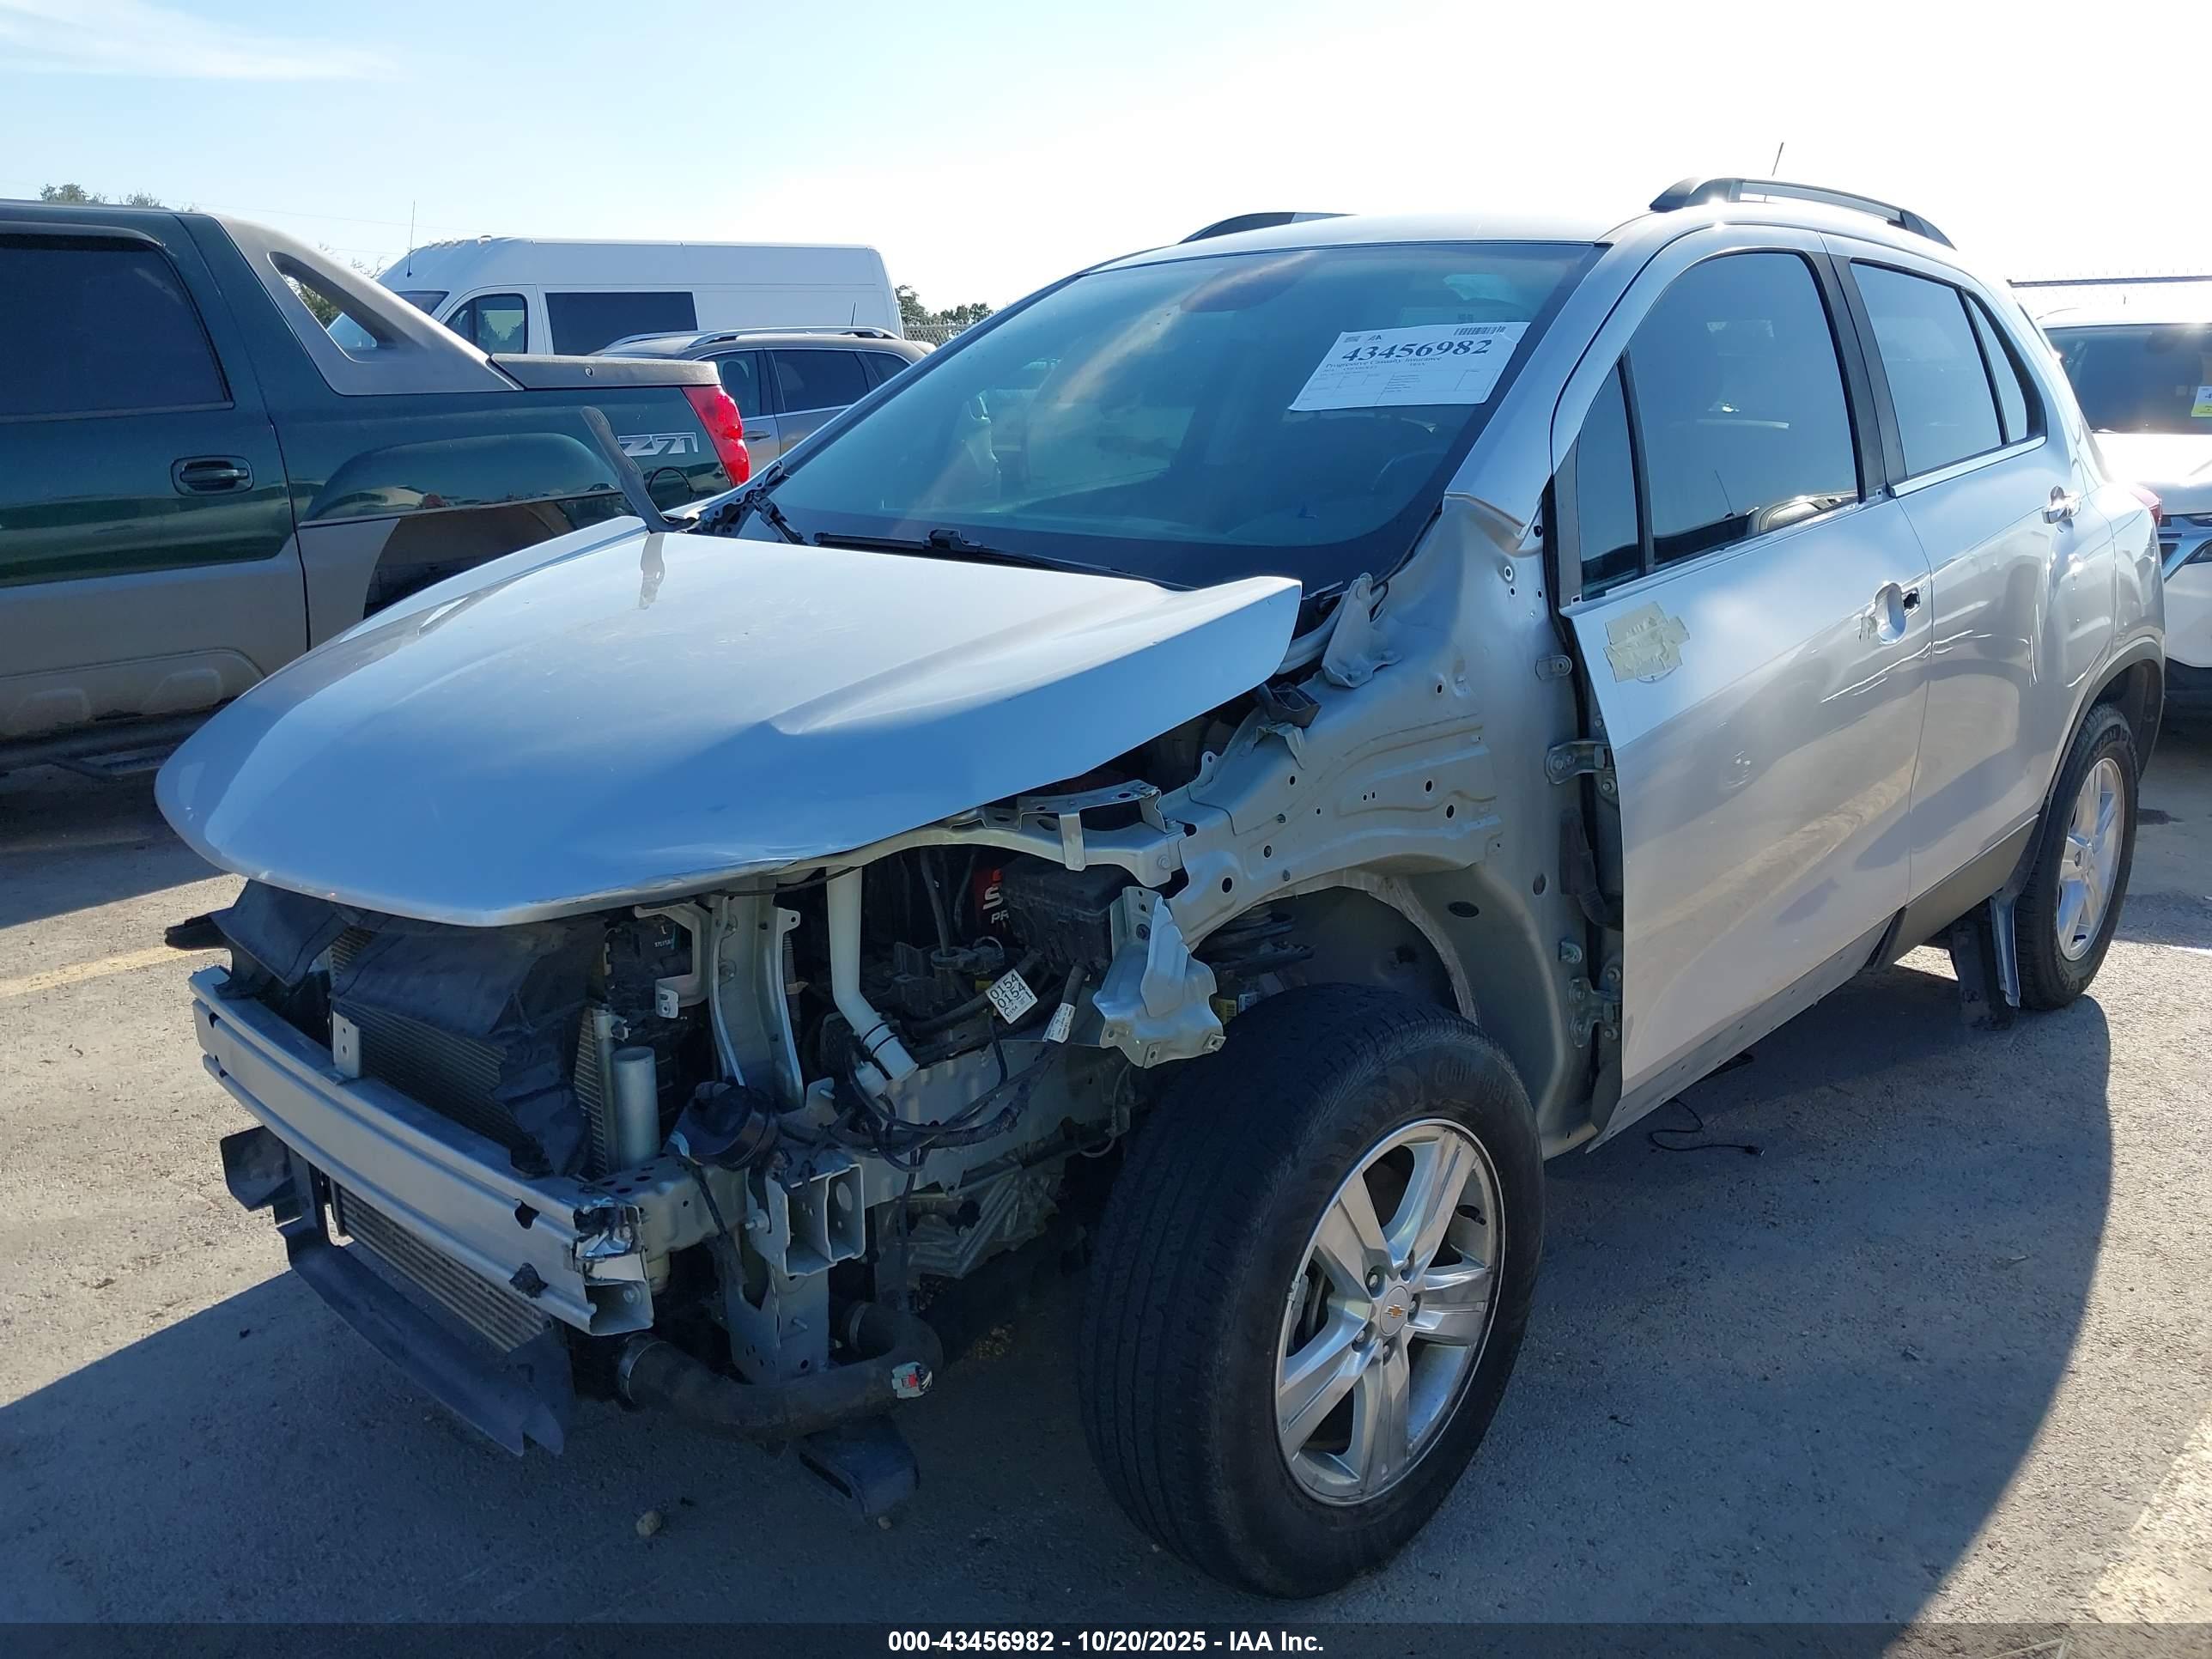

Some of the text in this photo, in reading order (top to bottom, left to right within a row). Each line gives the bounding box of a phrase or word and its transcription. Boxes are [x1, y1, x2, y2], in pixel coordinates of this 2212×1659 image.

[1341, 339, 1492, 362] 43456982
[617, 432, 699, 456] Z71
[991, 909, 1010, 924] PR
[989, 973, 1020, 1001] 0154
[996, 981, 1026, 1009] 0154
